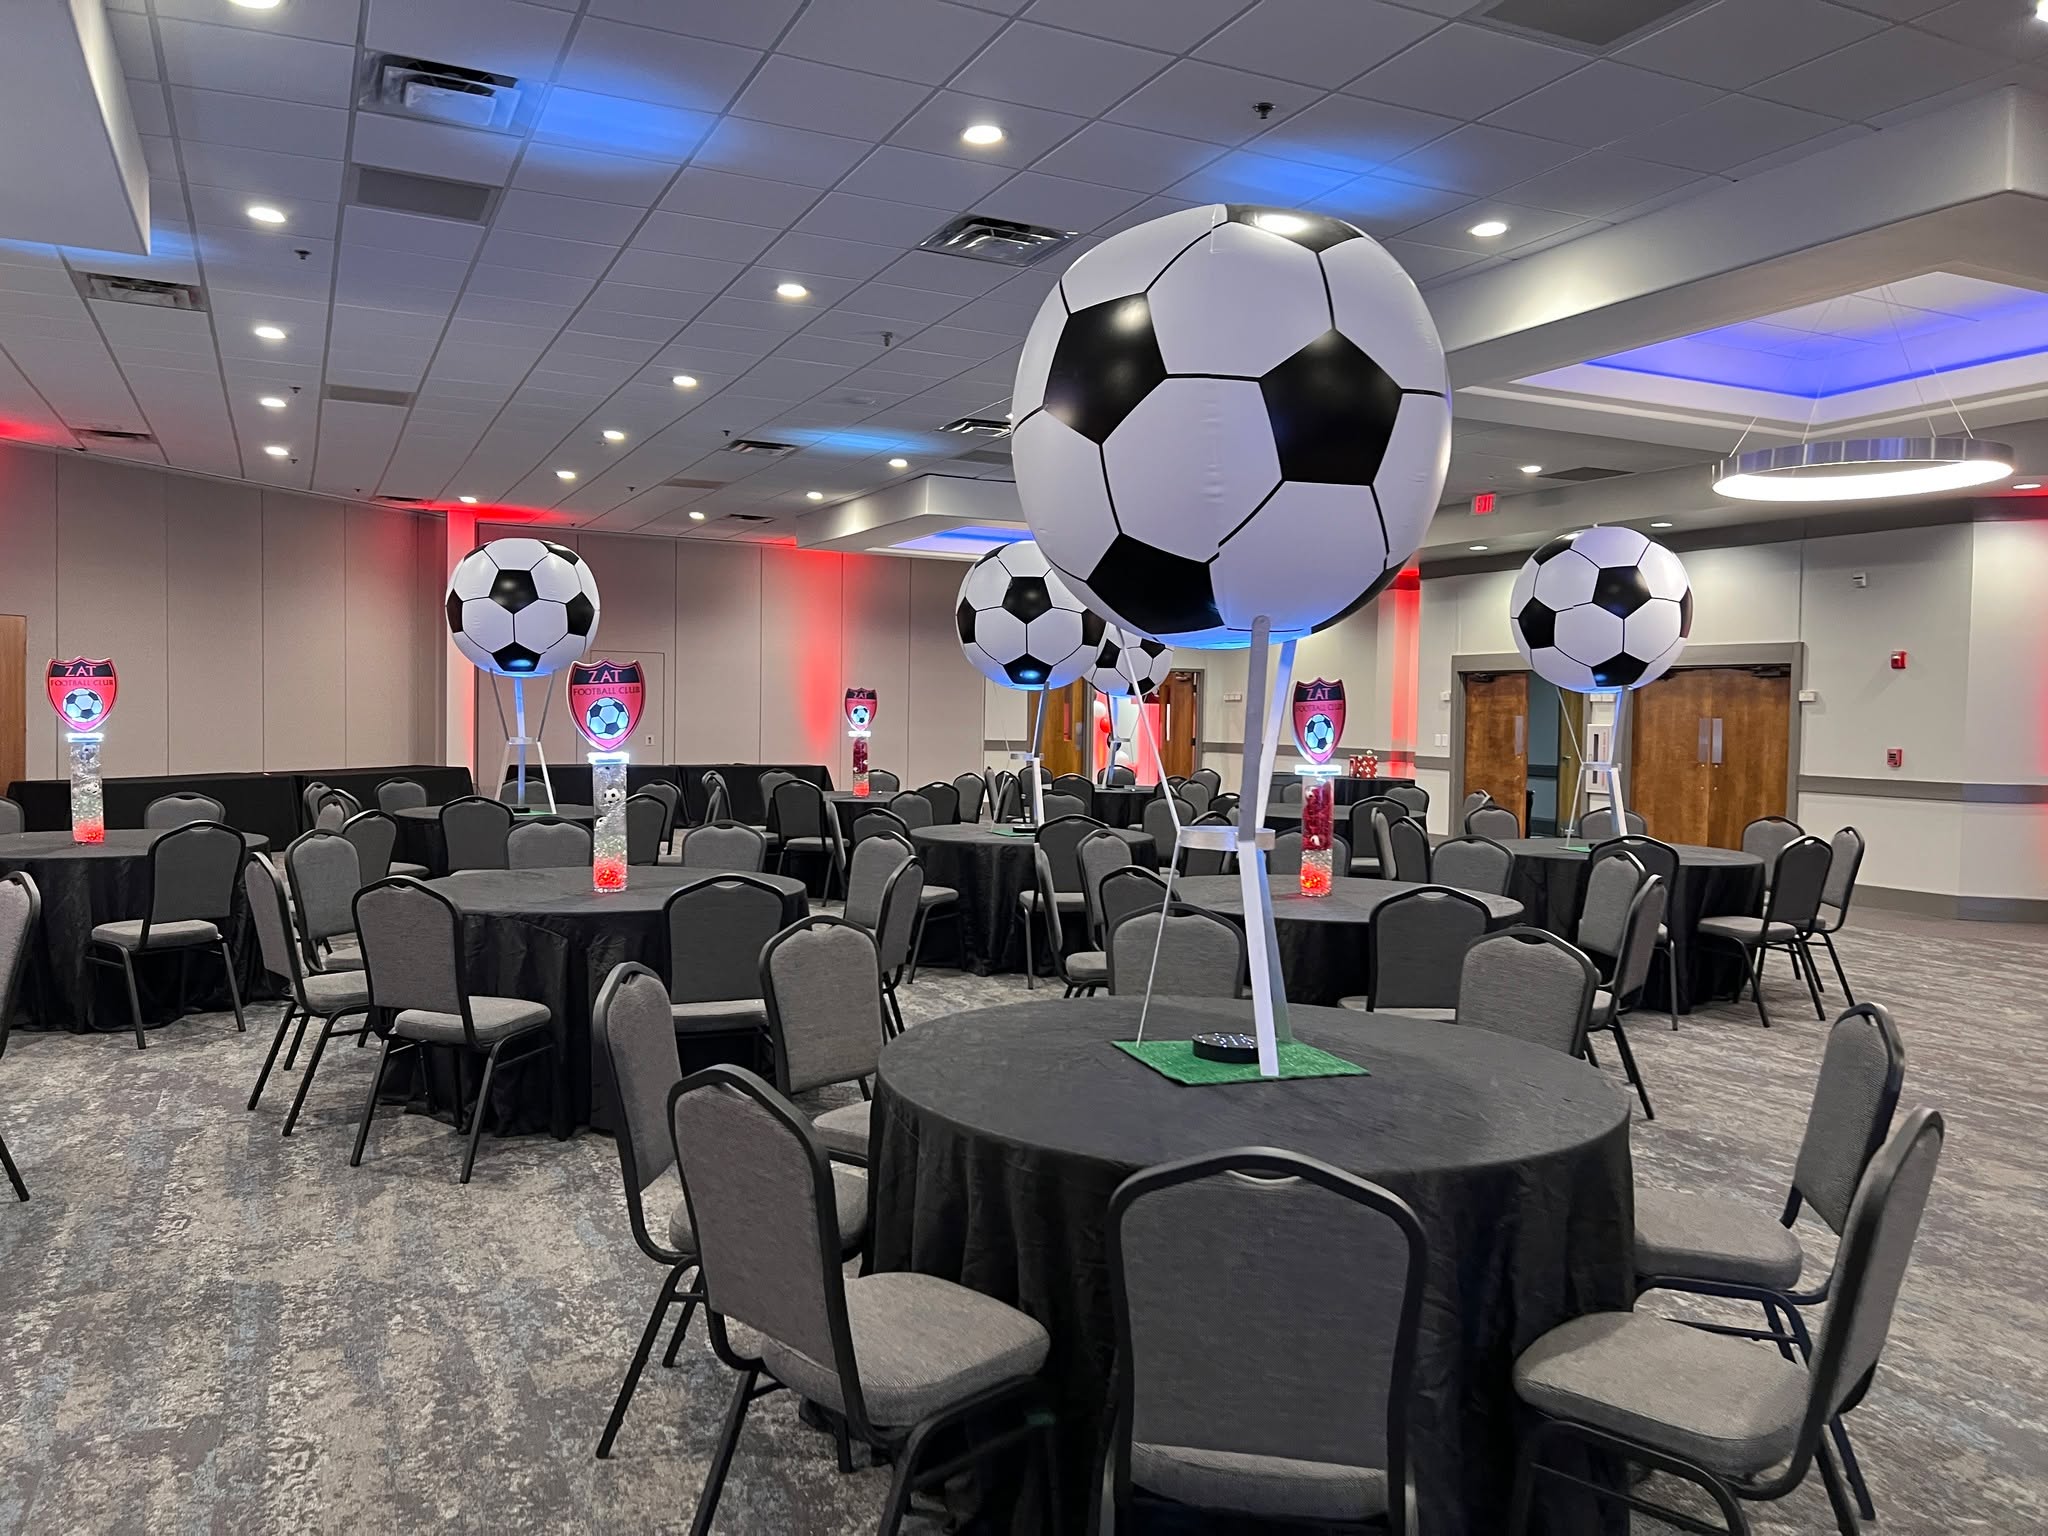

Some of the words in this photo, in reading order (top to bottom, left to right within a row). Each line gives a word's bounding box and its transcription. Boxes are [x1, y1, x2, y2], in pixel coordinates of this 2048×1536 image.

[1476, 495, 1493, 512] EXIT
[64, 666, 97, 677] ZAT
[588, 670, 623, 684] ZAT
[51, 679, 90, 687] FOOTBALL
[92, 679, 114, 687] CLUB
[573, 687, 616, 696] FOOTBALL
[618, 686, 641, 695] CLUB
[853, 691, 868, 699] ZAT
[1306, 688, 1331, 701] ZAT
